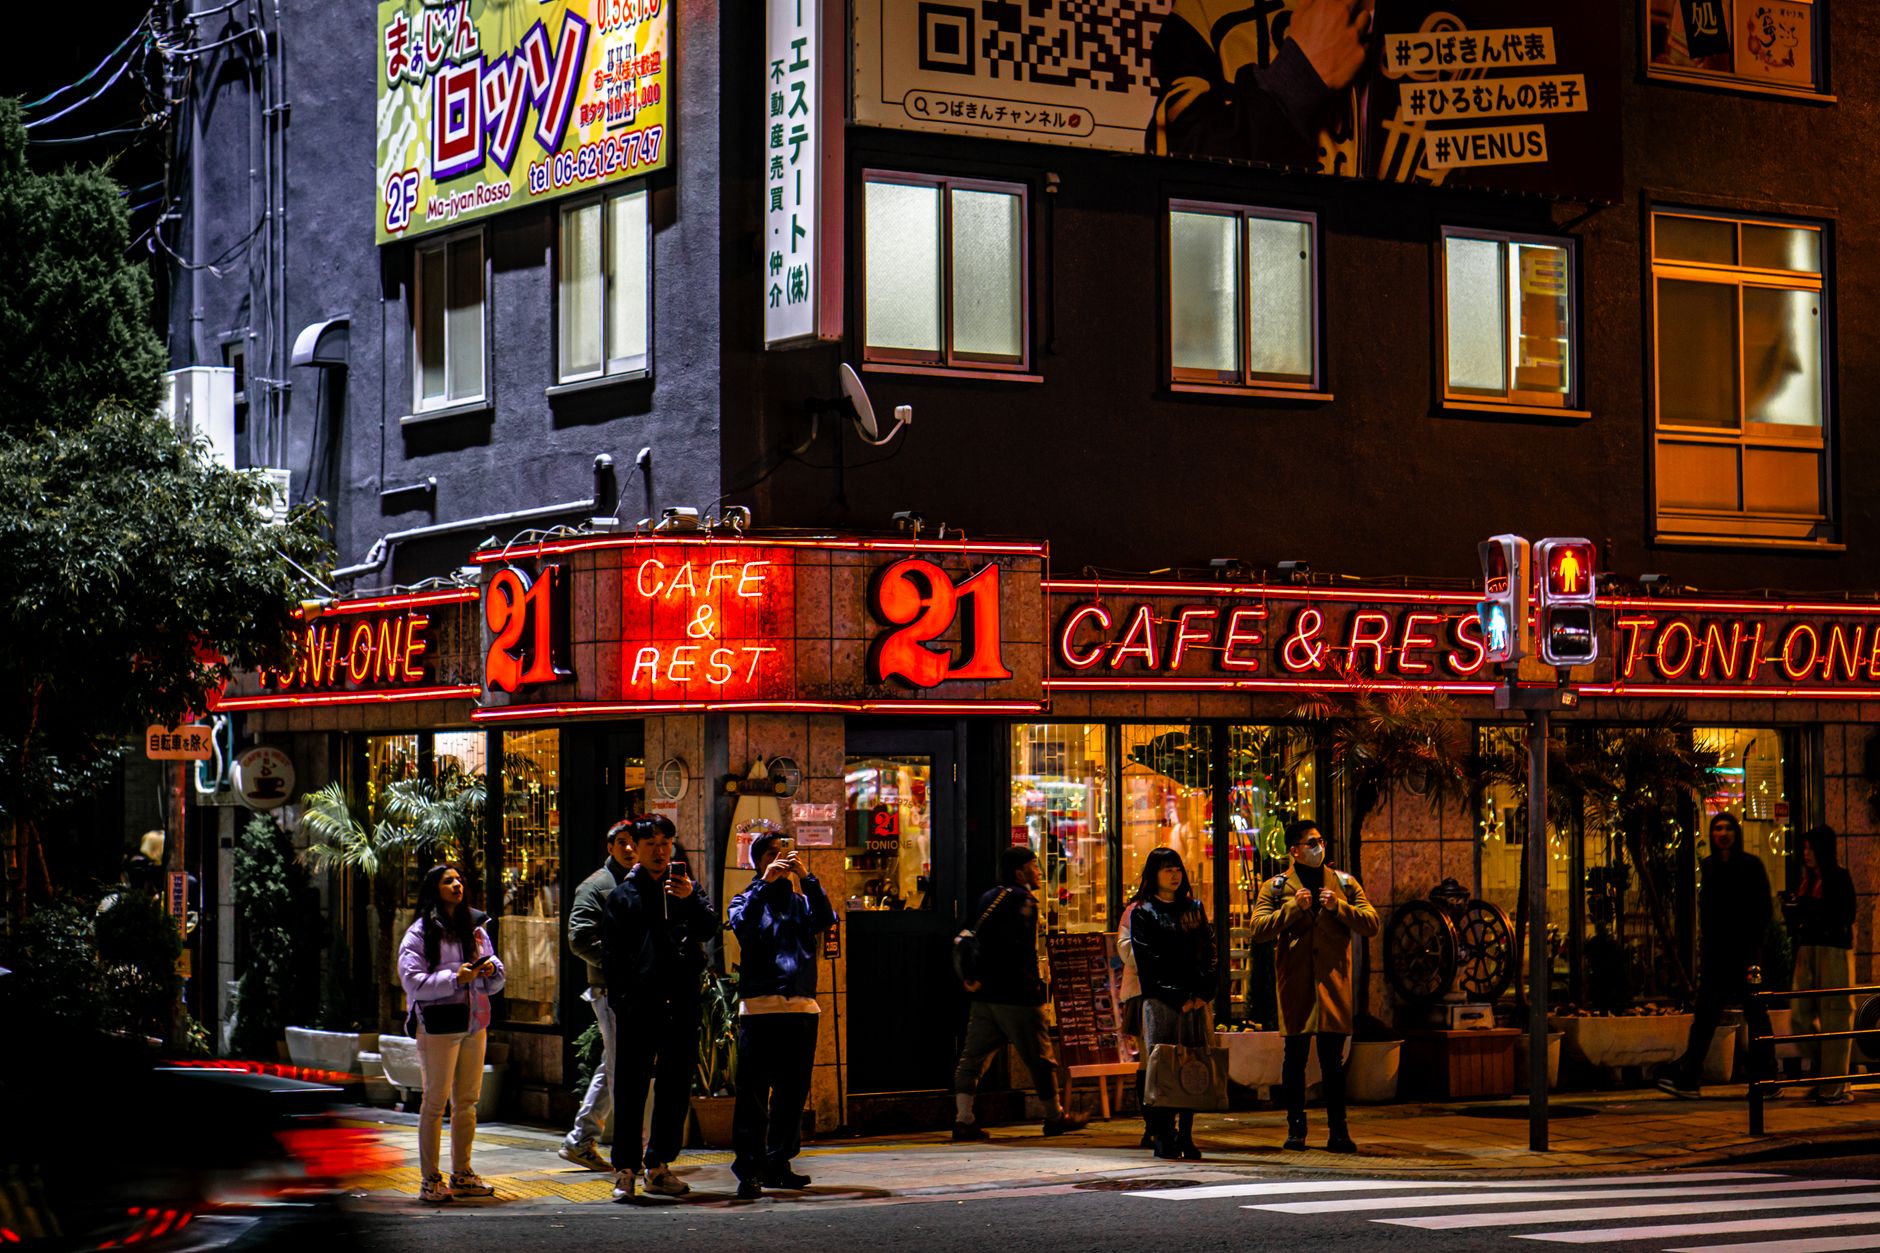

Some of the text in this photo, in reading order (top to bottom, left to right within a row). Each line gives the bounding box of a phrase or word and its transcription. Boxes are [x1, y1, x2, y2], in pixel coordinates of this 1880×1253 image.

[1395, 33, 1546, 66] #つばきん代表
[434, 15, 585, 172] ロッソ
[1410, 80, 1580, 116] #ひろむんの弟子
[934, 101, 1067, 129] つばきんチャンネル
[529, 129, 661, 192] tel 06-6212-7747
[1435, 131, 1543, 163] #VENUS
[387, 175, 417, 228] 2F
[427, 182, 511, 219] Ma-jyan Rosso
[769, 59, 785, 308] 不動産売買・仲介
[637, 559, 770, 598] CAFE
[486, 564, 559, 693] 21
[686, 604, 715, 640] &
[879, 558, 1014, 689] 21
[1062, 602, 1487, 678] CAFE & RES
[258, 624, 339, 688] NI
[631, 645, 776, 685] REST
[150, 733, 208, 752] 自転車を除く
[874, 812, 902, 837] 21
